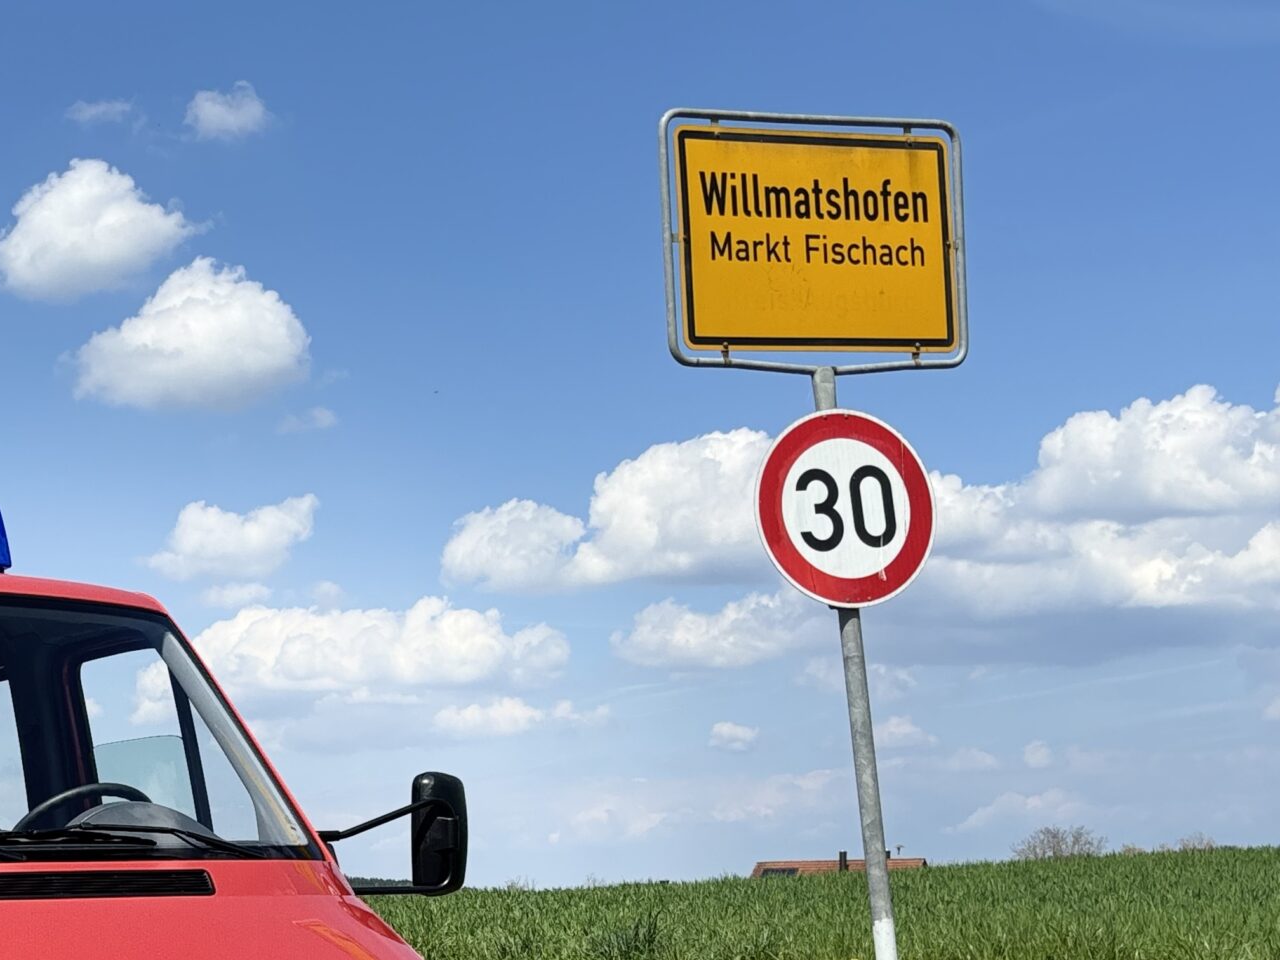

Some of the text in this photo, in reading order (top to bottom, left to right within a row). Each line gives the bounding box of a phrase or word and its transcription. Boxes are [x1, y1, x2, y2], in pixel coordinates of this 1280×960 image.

[699, 171, 929, 223] Willmatshofen
[710, 231, 925, 267] Markt Fischach
[795, 465, 896, 552] 30
